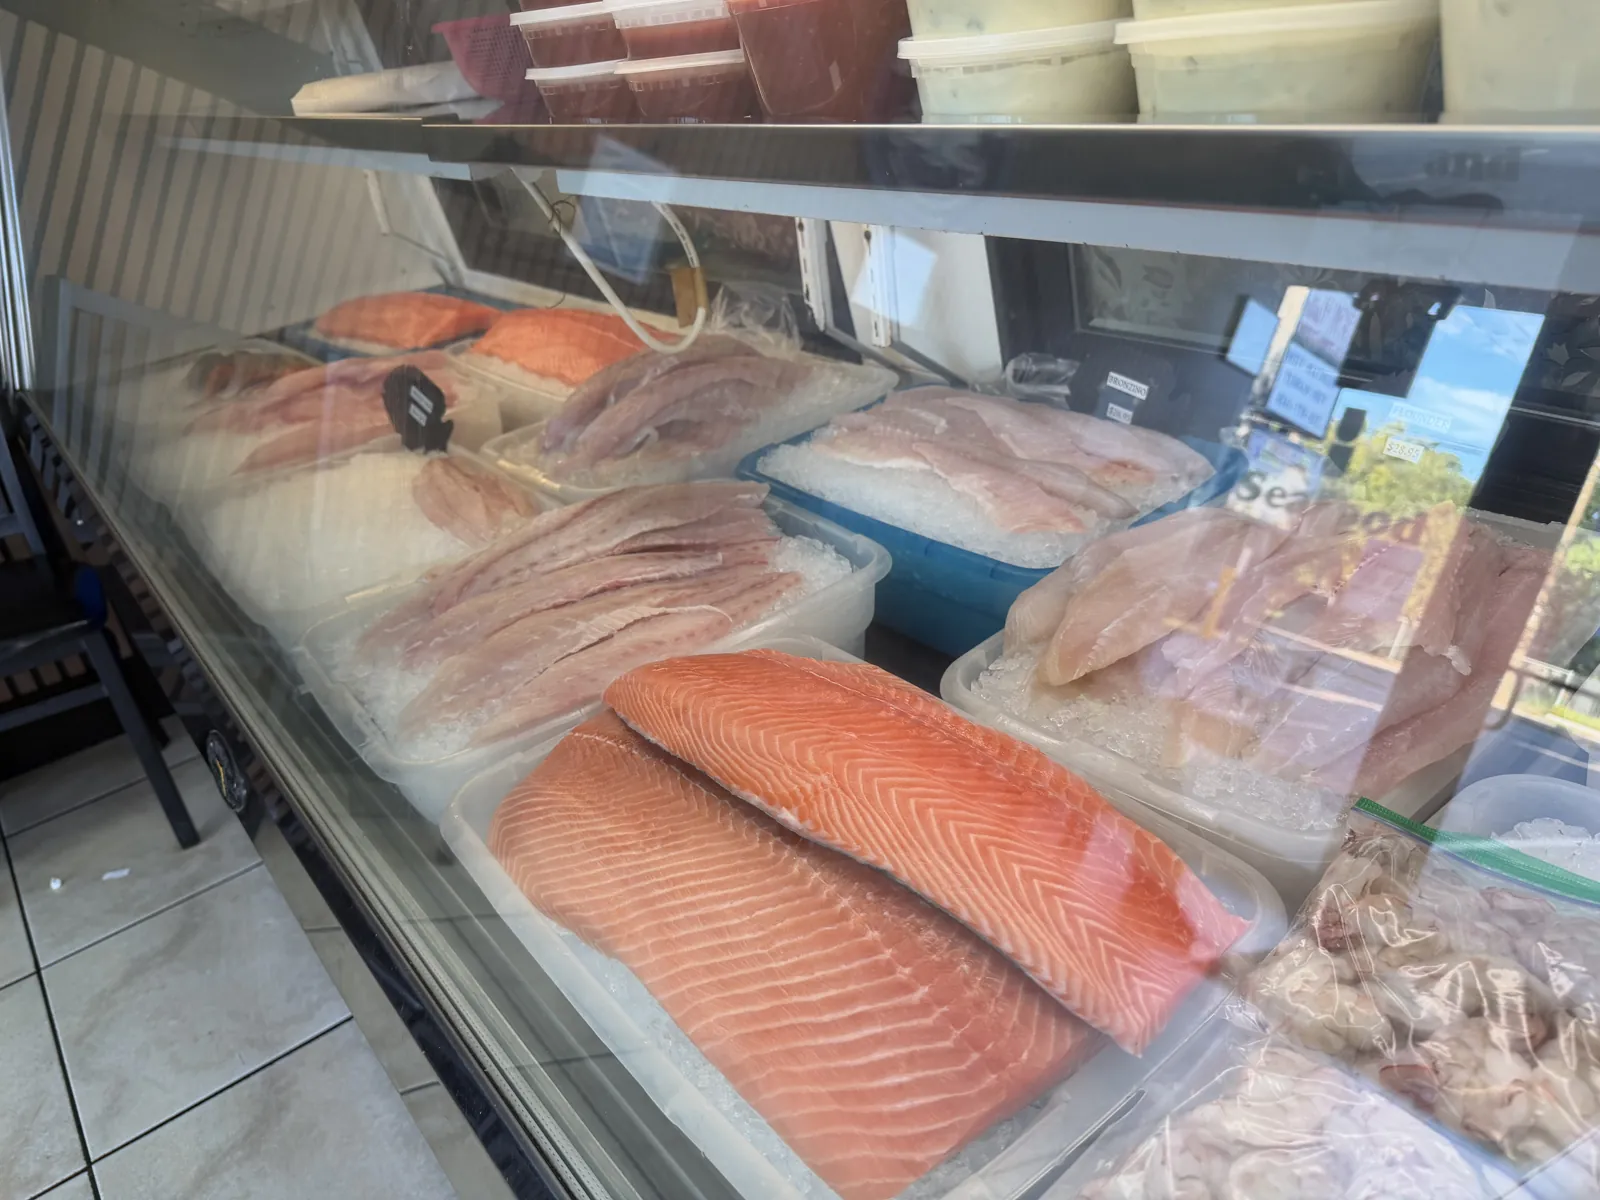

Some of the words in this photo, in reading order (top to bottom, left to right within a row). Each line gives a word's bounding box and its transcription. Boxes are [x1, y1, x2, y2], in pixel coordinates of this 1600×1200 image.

[1108, 375, 1147, 397] BRONZINO
[1392, 405, 1450, 430] FLOUNDER
[1387, 443, 1420, 459] $28.95
